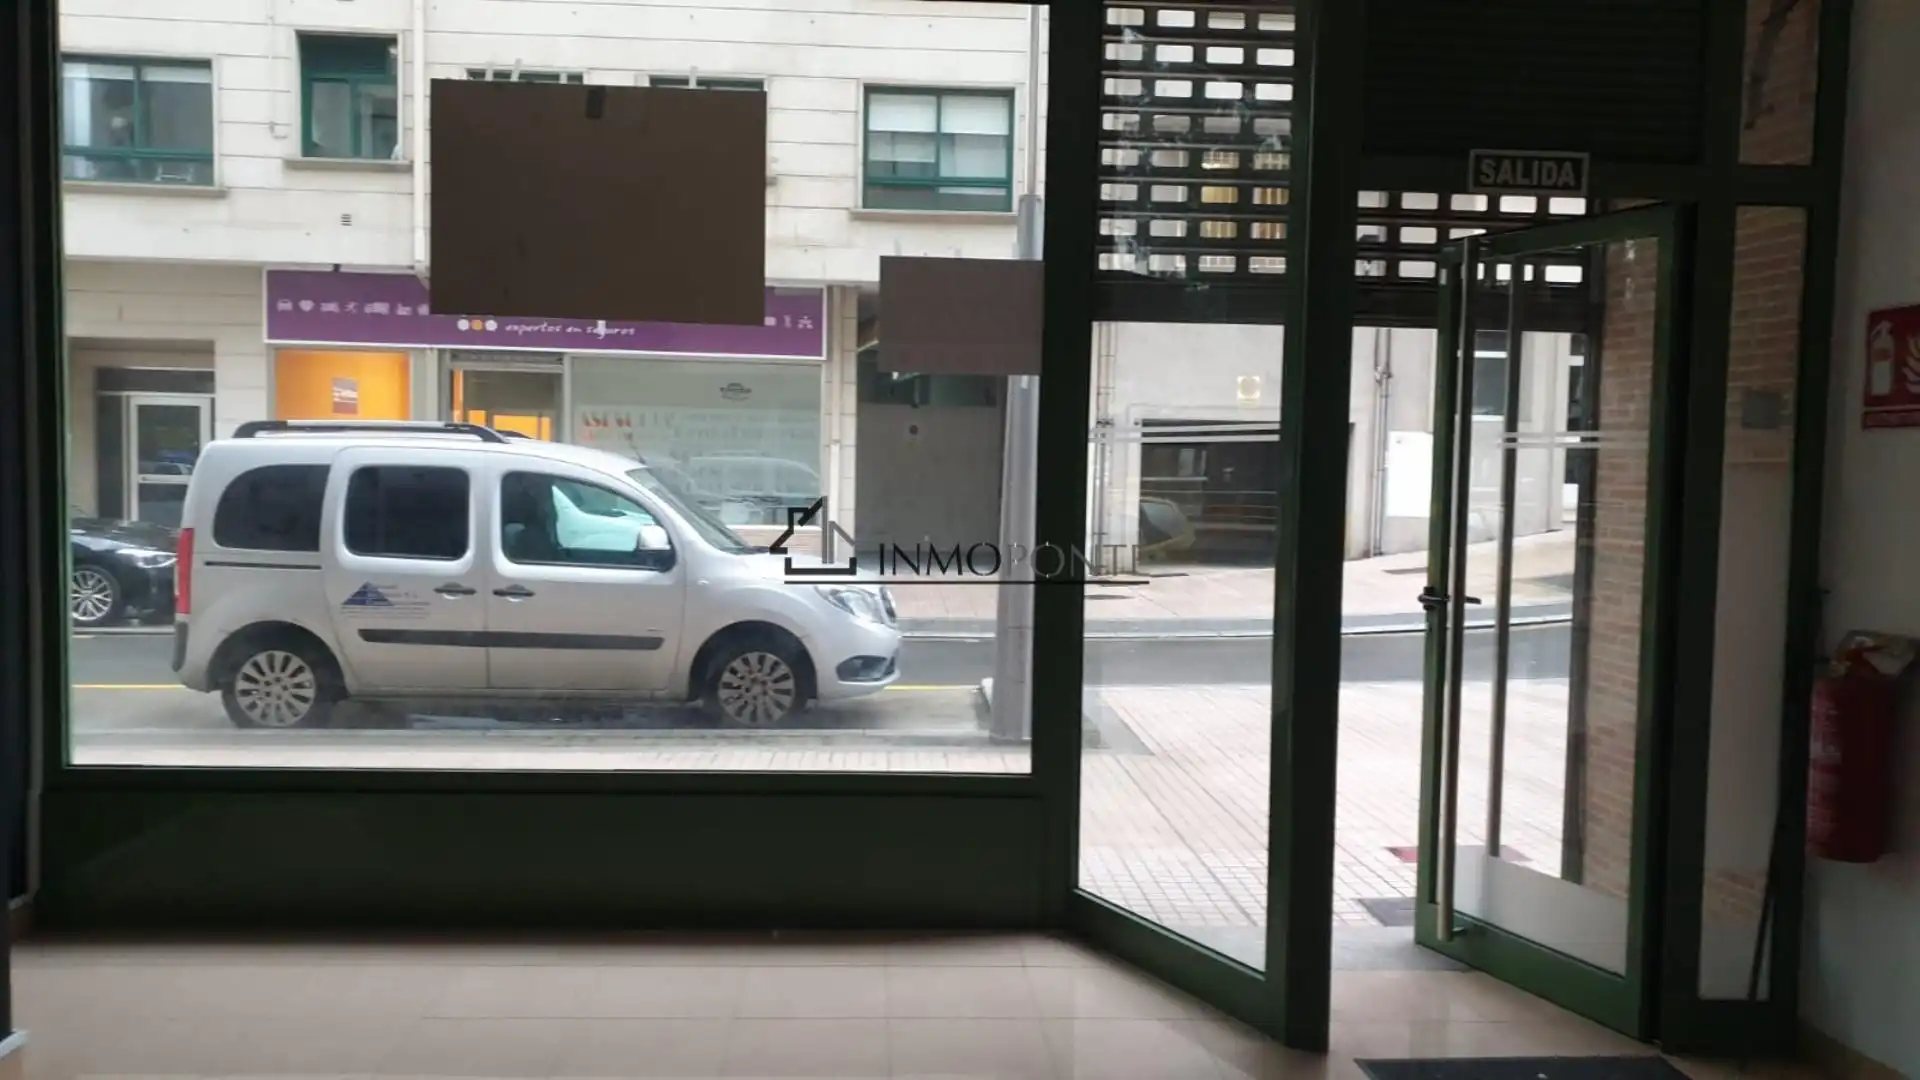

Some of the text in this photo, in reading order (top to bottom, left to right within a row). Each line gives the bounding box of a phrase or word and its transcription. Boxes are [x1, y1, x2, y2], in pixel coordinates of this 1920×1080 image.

[1479, 158, 1576, 187] SALIDA
[505, 320, 562, 336] expertos
[565, 325, 583, 333] en
